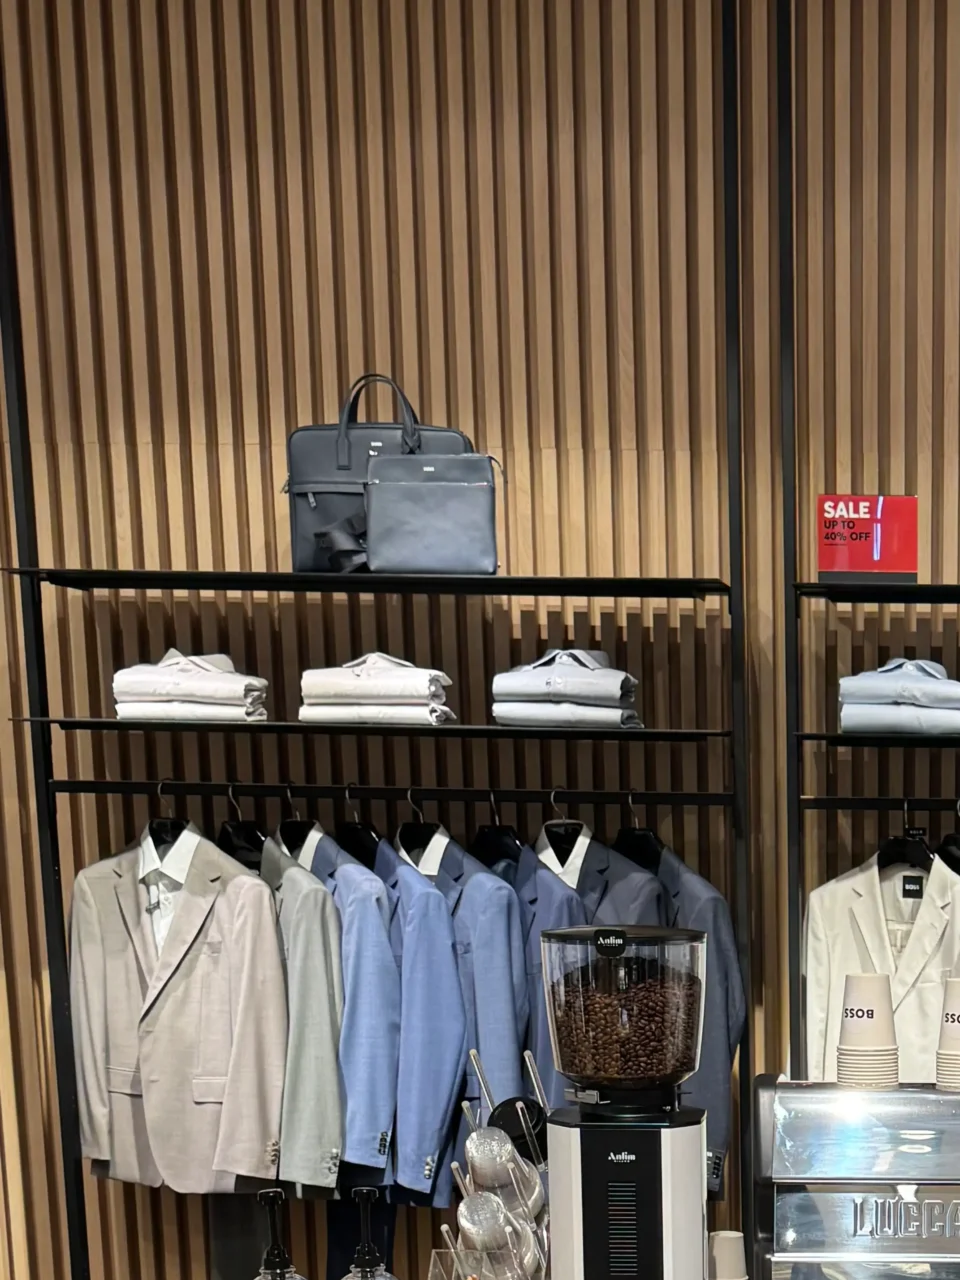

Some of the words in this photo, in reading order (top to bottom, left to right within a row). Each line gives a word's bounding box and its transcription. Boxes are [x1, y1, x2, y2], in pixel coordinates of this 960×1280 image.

[823, 501, 870, 518] SALE
[823, 520, 839, 530] UP
[841, 520, 856, 530] TO
[823, 531, 847, 541] 40%
[849, 531, 871, 541] OFF
[844, 1008, 874, 1019] BOSS
